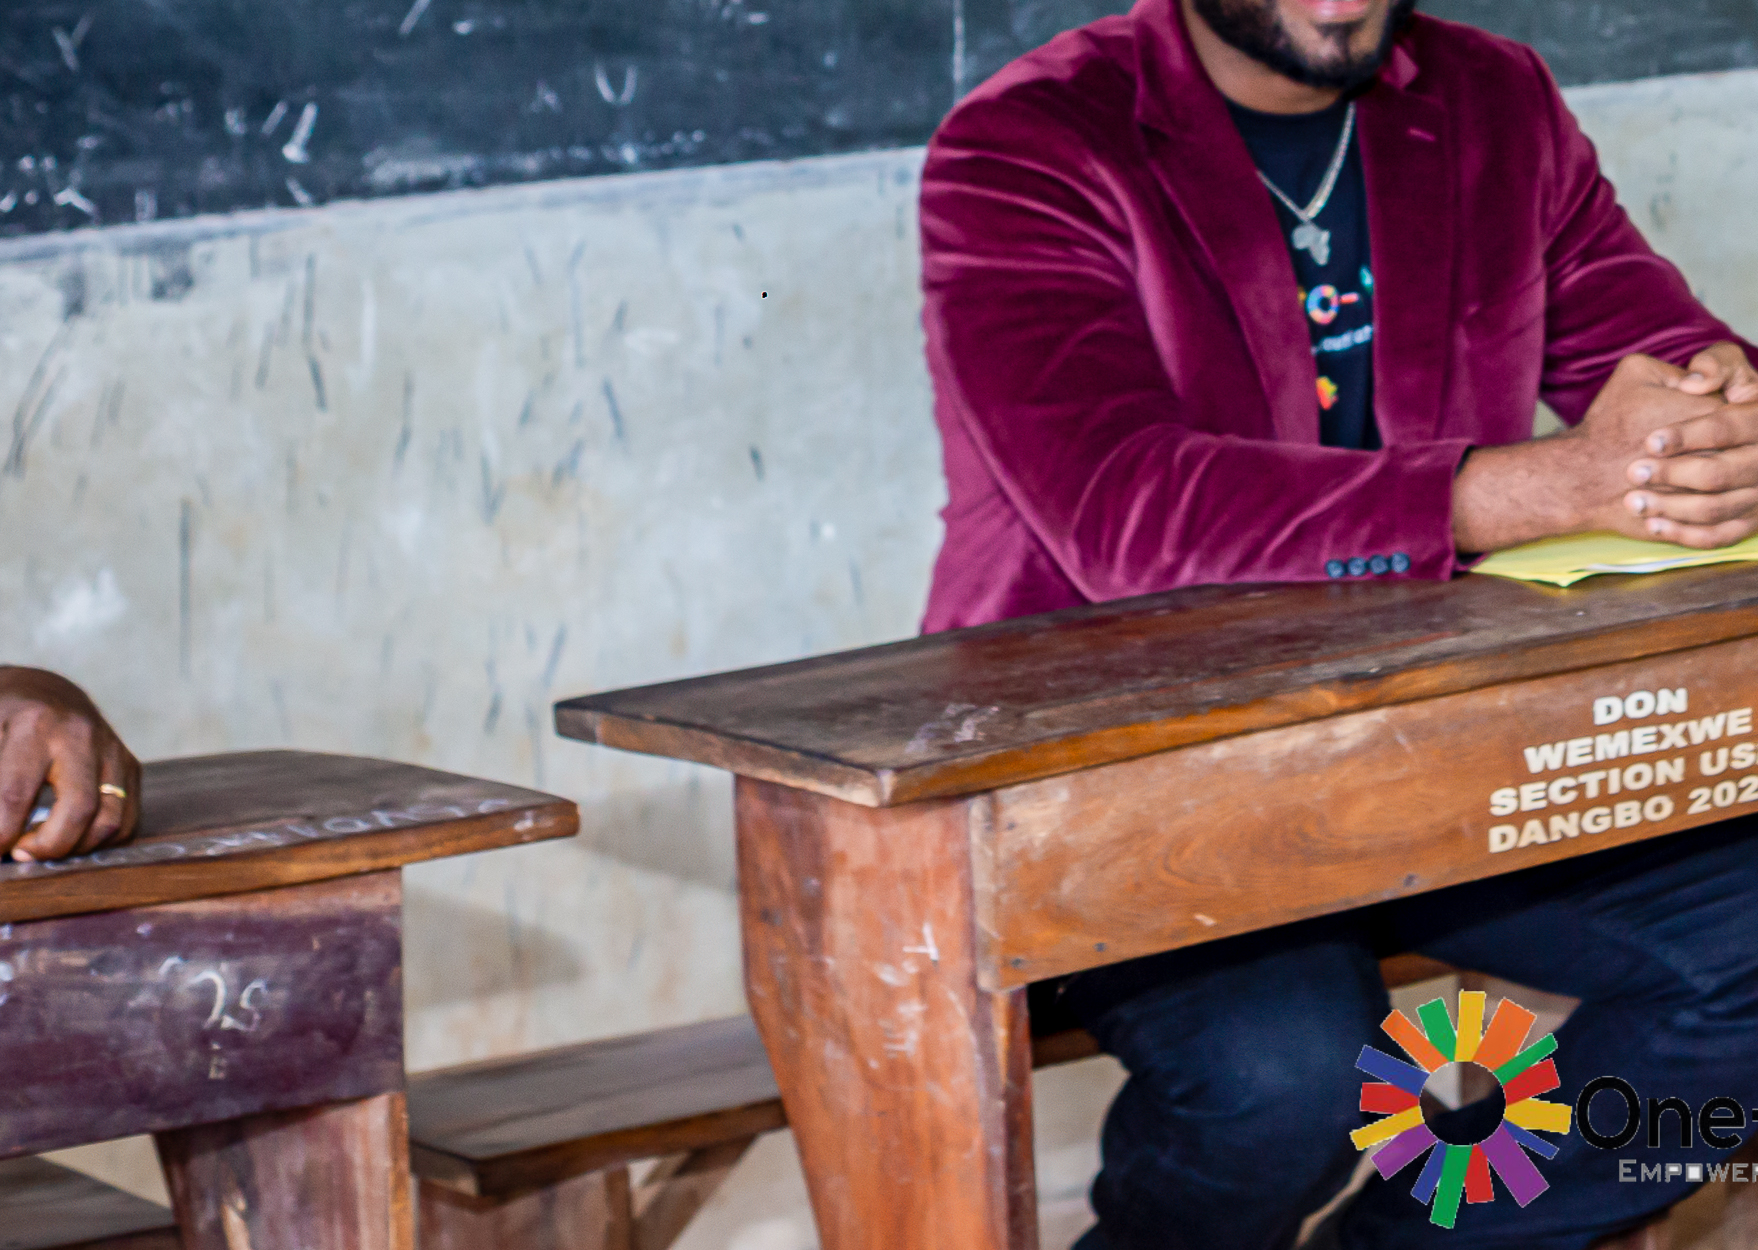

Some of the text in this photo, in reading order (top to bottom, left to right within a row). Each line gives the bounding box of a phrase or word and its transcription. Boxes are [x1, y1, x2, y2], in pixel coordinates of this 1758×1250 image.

[1592, 687, 1688, 726] DON
[1523, 707, 1753, 774] WEMEXWE
[1489, 757, 1685, 817] SECTION
[1488, 794, 1675, 854] DANGBO
